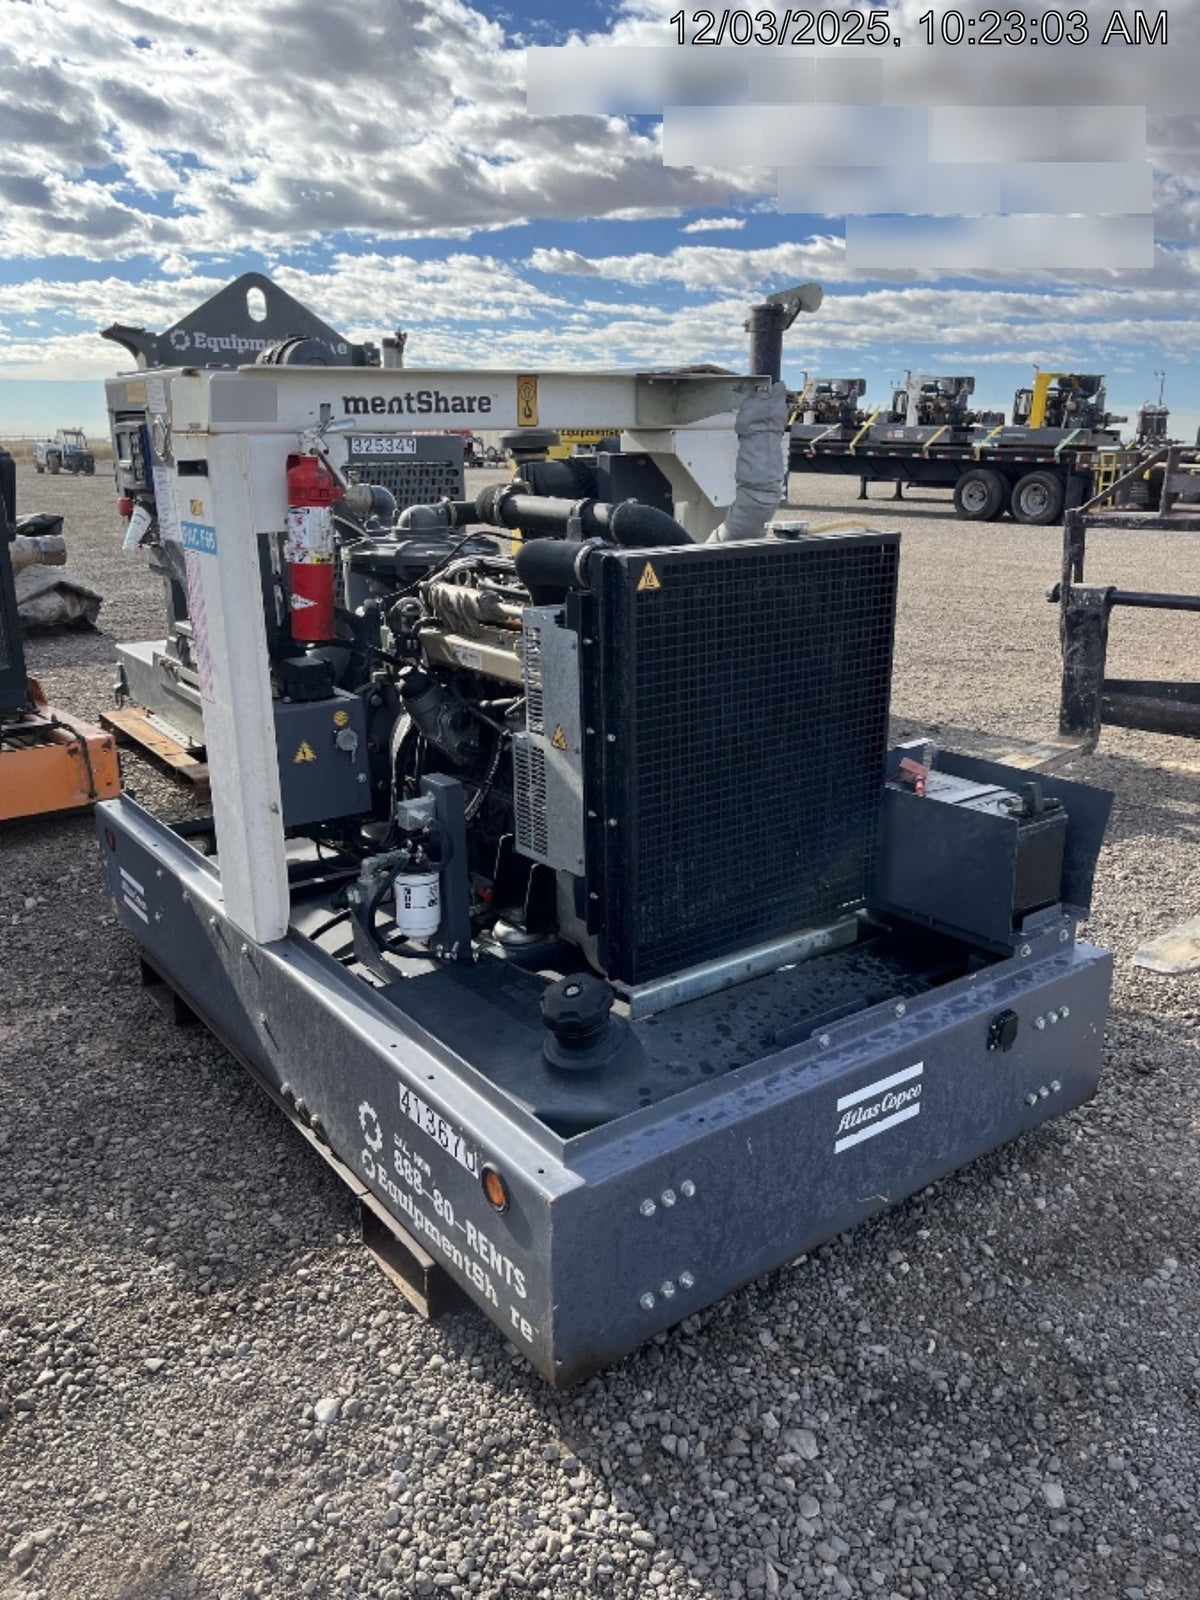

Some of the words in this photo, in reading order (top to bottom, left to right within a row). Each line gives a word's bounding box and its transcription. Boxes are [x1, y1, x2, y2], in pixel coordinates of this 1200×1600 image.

[353, 438, 415, 453] 325349
[835, 1103, 881, 1134] Atlas
[881, 1083, 923, 1113] Copco
[377, 1163, 534, 1344] EquipmentShre
